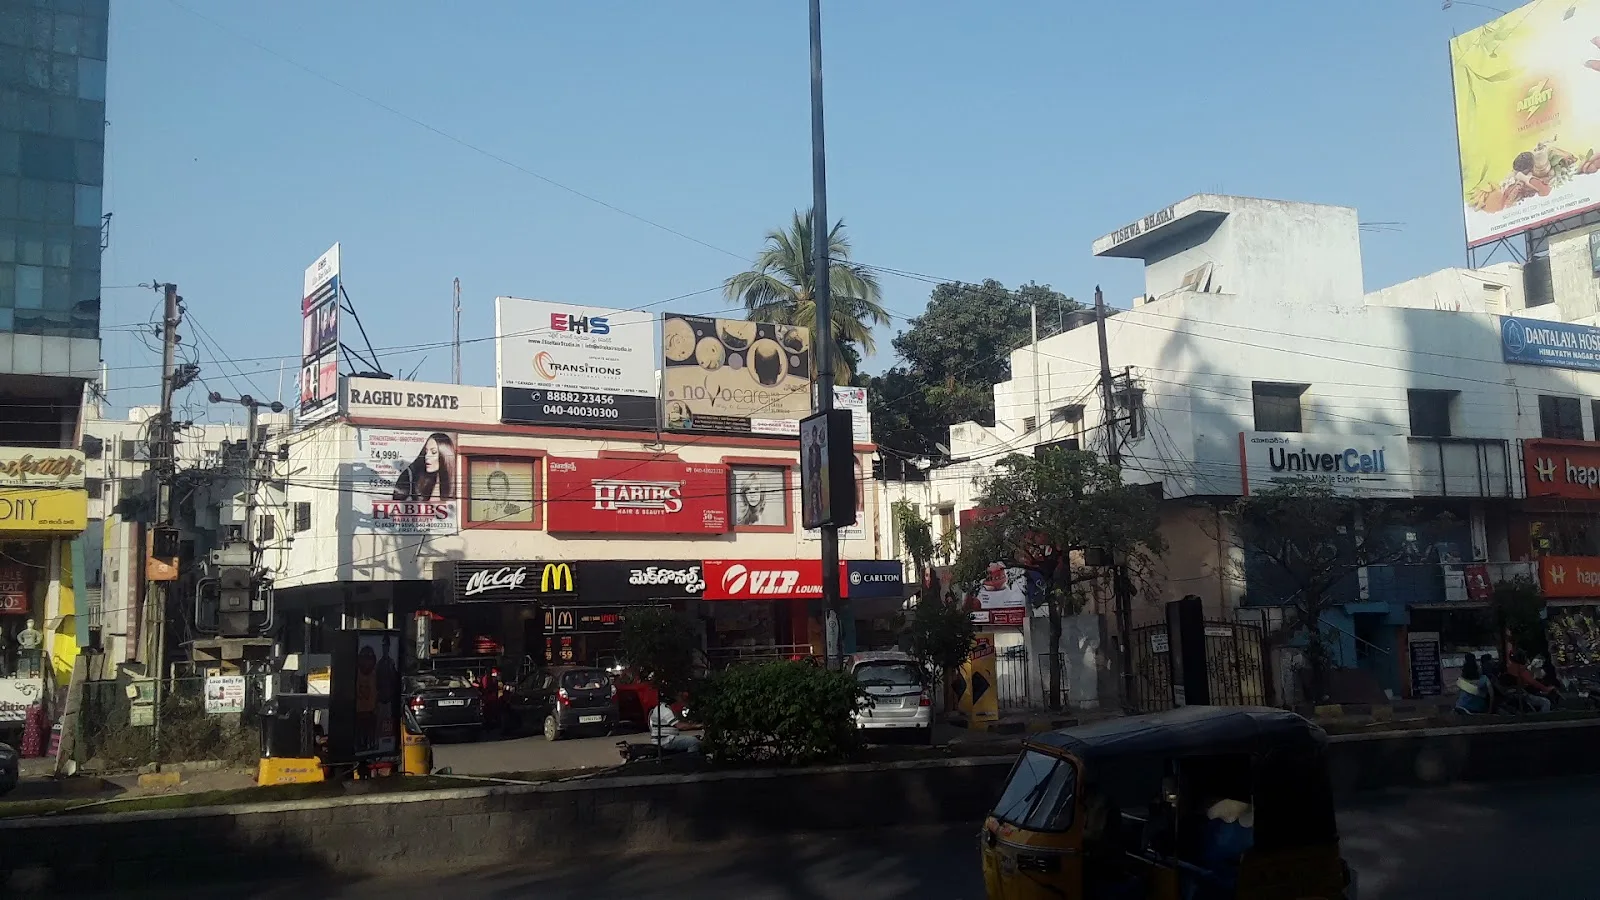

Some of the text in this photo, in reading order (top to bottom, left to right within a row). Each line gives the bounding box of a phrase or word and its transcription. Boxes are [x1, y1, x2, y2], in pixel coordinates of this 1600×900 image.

[1110, 205, 1175, 245] VISHWA BHAVAN
[551, 312, 610, 335] EHS
[1525, 327, 1578, 348] DANTALAYA
[1539, 348, 1572, 357] HIMAYATH
[1573, 351, 1594, 360] NAGAR
[350, 388, 459, 410] RAGHU ESTATE
[546, 391, 615, 405] 88882 23456
[543, 404, 619, 419] 040-40030300
[1268, 447, 1386, 473] UniverCell
[1337, 475, 1360, 484] Expert
[592, 484, 683, 513] HABIBS
[371, 503, 449, 519] HABIBS
[864, 574, 900, 582] CARLTON
